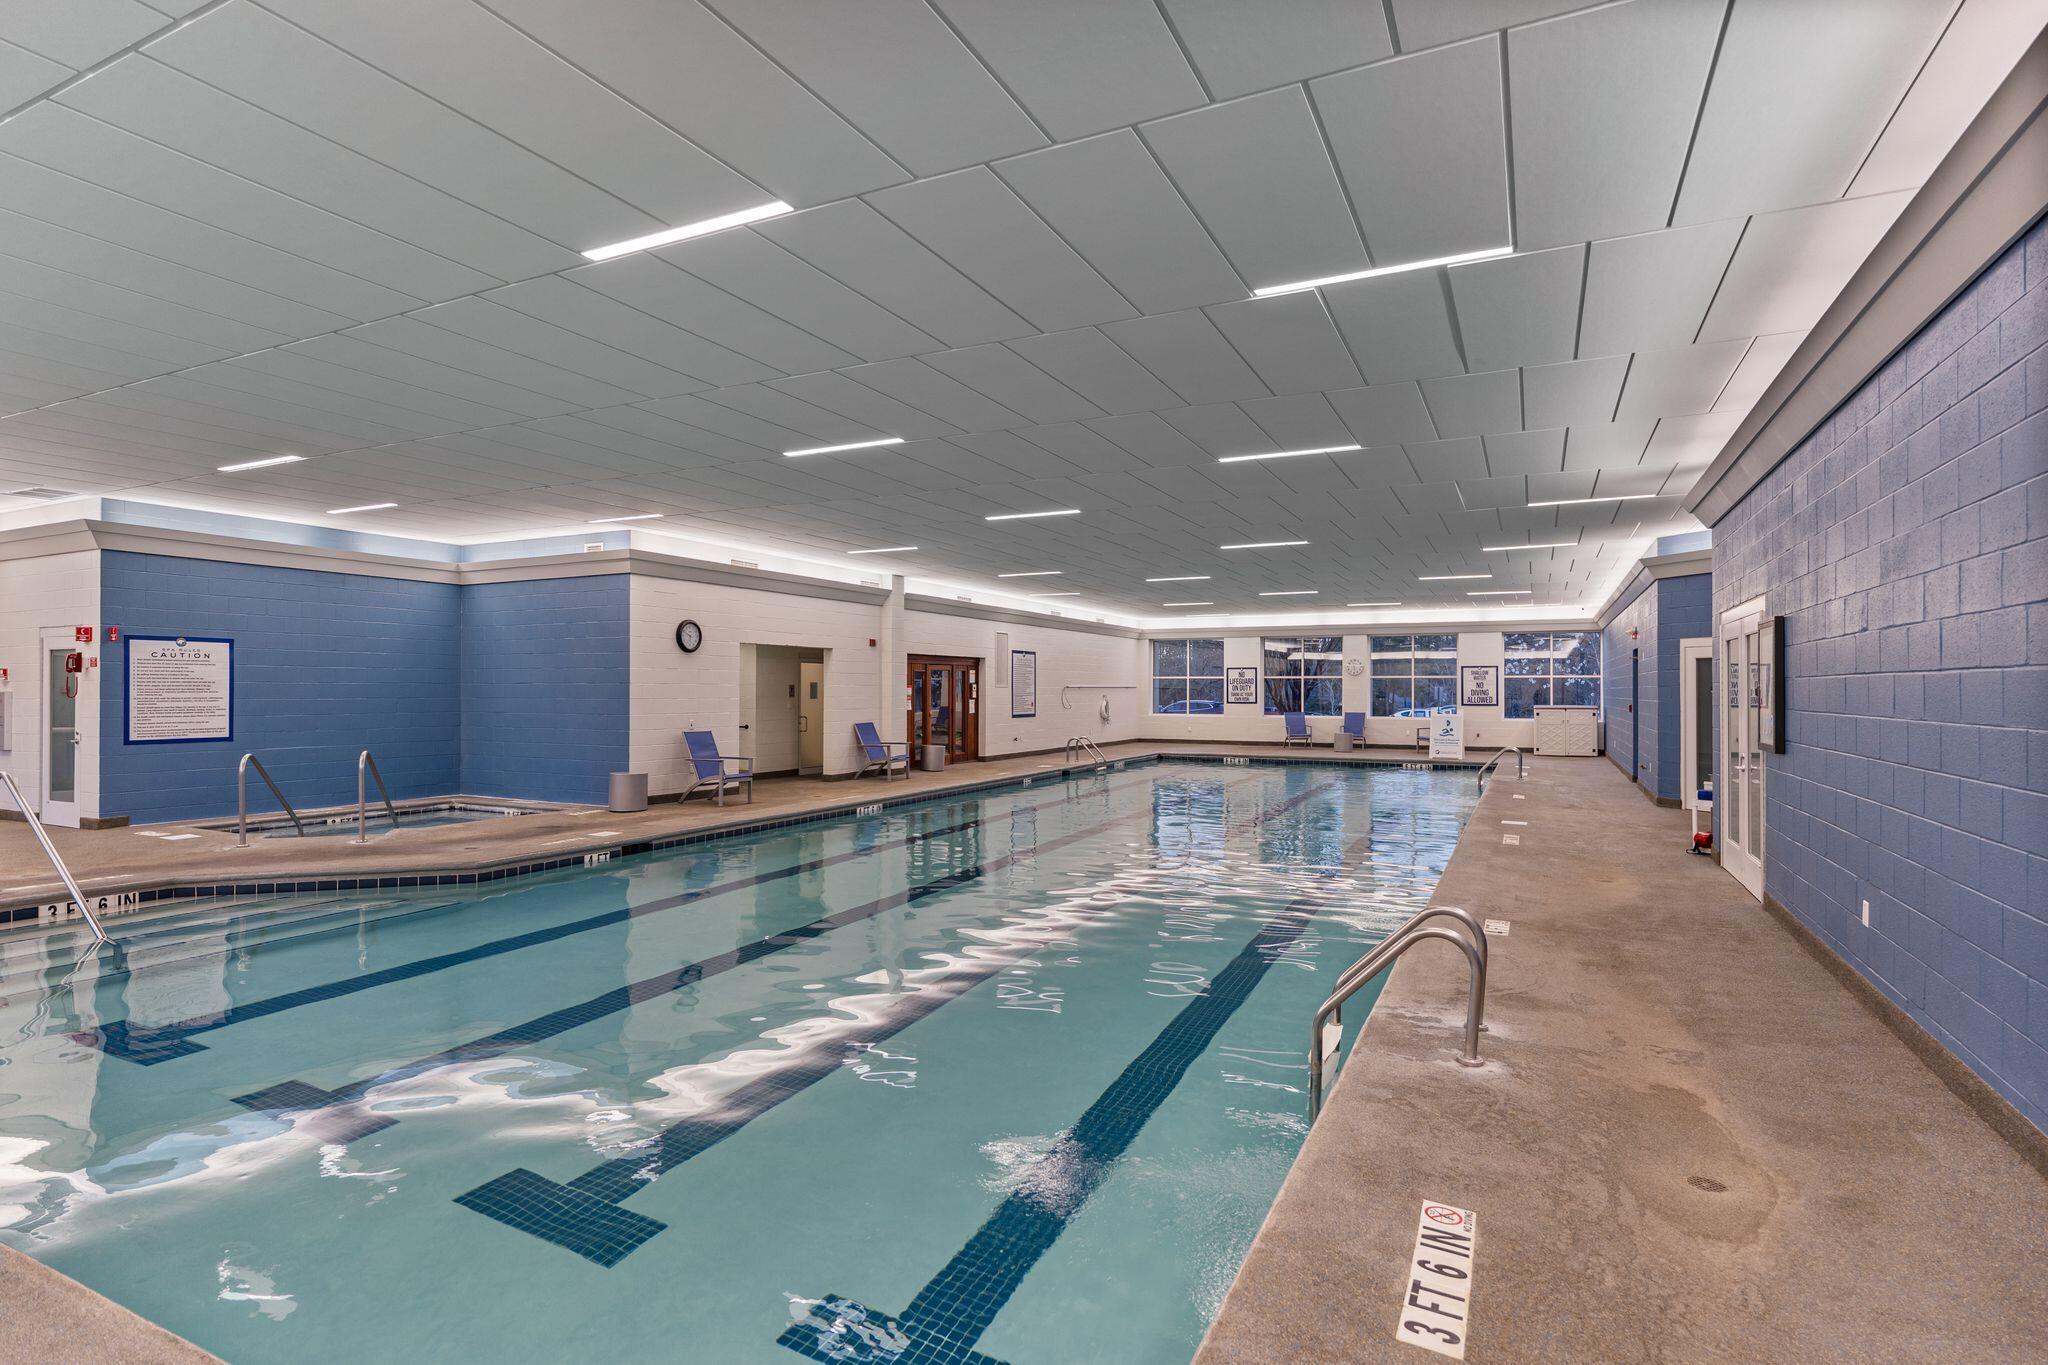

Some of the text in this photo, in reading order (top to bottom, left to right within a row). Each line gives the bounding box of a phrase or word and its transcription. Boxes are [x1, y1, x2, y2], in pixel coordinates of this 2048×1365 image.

[1467, 696, 1493, 704] ALLOWED
[98, 897, 108, 909] 6
[117, 893, 136, 906] IN
[1404, 1225, 1471, 1345] 3 FT 6 IN
